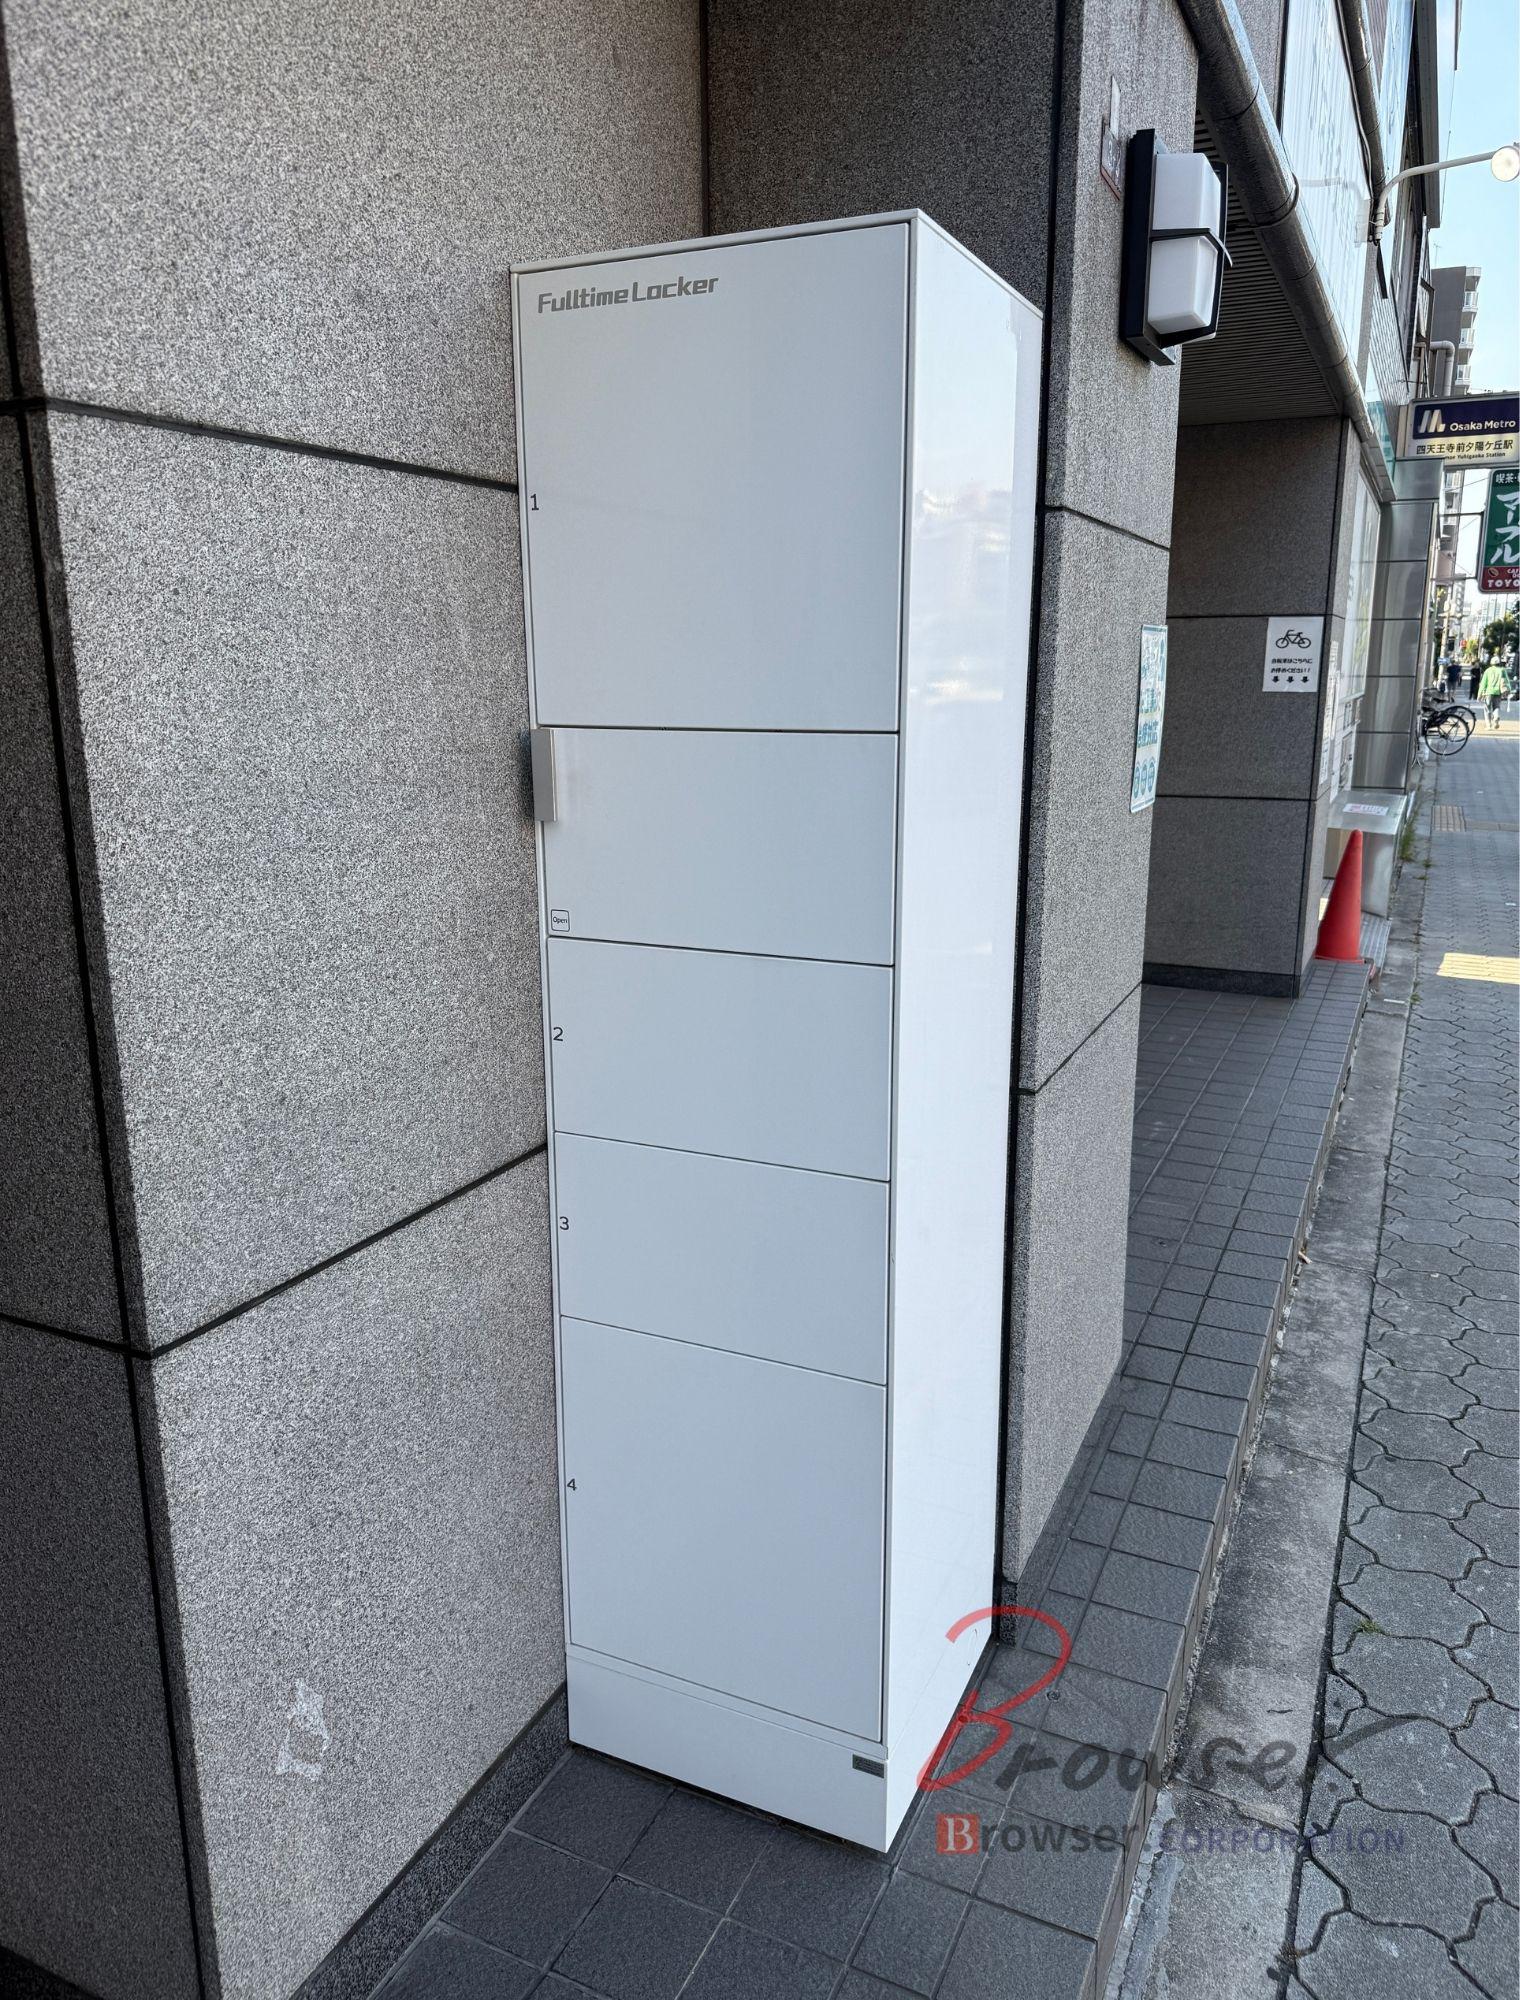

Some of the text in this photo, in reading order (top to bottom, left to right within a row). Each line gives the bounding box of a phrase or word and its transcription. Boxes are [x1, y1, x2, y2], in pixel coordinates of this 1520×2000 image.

[537, 276, 719, 314] Fulltime Locker
[1449, 420, 1516, 432] Osaka Metro
[530, 493, 540, 511] 1
[552, 916, 568, 924] Open
[553, 1026, 564, 1042] 2
[559, 1216, 570, 1231] 3
[566, 1478, 577, 1491] 4
